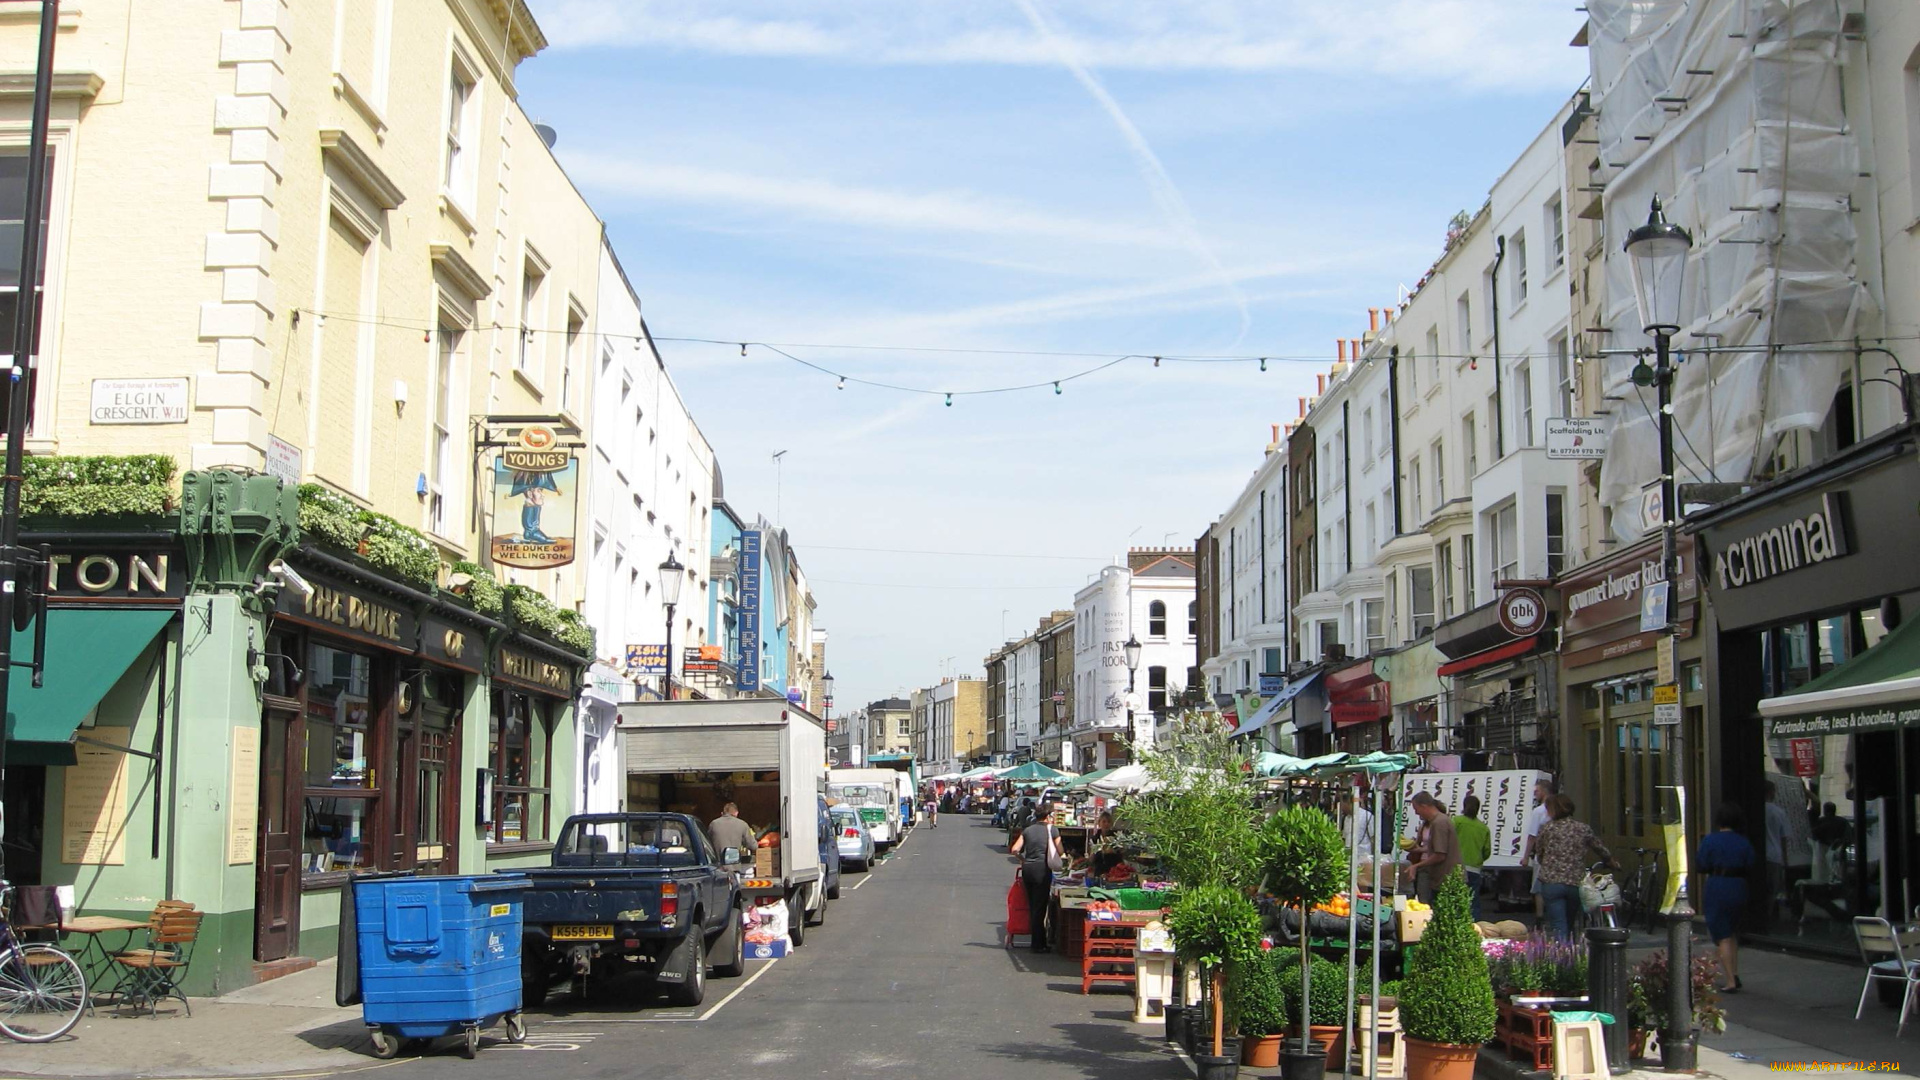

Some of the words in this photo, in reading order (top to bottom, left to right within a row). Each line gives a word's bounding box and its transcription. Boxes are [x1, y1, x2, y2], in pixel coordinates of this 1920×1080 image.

[114, 392, 166, 406] ELGIN
[1550, 428, 1592, 436] Scaffolding
[1566, 420, 1590, 428] Trojan
[268, 456, 300, 480] PORTOBELLO
[509, 454, 564, 466] YOUNG'S
[1727, 492, 1838, 587] criminal
[1568, 580, 1608, 618] gourmet
[1608, 570, 1642, 600] burger
[305, 584, 346, 625] THE
[742, 536, 758, 686] ELECTRIC
[1511, 604, 1534, 620] gbk
[627, 645, 660, 656] FISH
[1102, 640, 1127, 653] FIRST
[631, 656, 668, 666] CHIPS
[1102, 656, 1128, 668] FLOOR
[1772, 719, 1806, 734] Fairtrade
[1806, 716, 1830, 732] coffee,
[1832, 716, 1849, 729] teas
[1850, 713, 1857, 726] &
[1858, 710, 1896, 726] chocolate,
[1481, 776, 1492, 826] coTherm
[1512, 775, 1528, 834] EcoTherm
[1492, 798, 1508, 856] EcoTherm
[557, 927, 586, 937] K555
[588, 927, 610, 936] DEV
